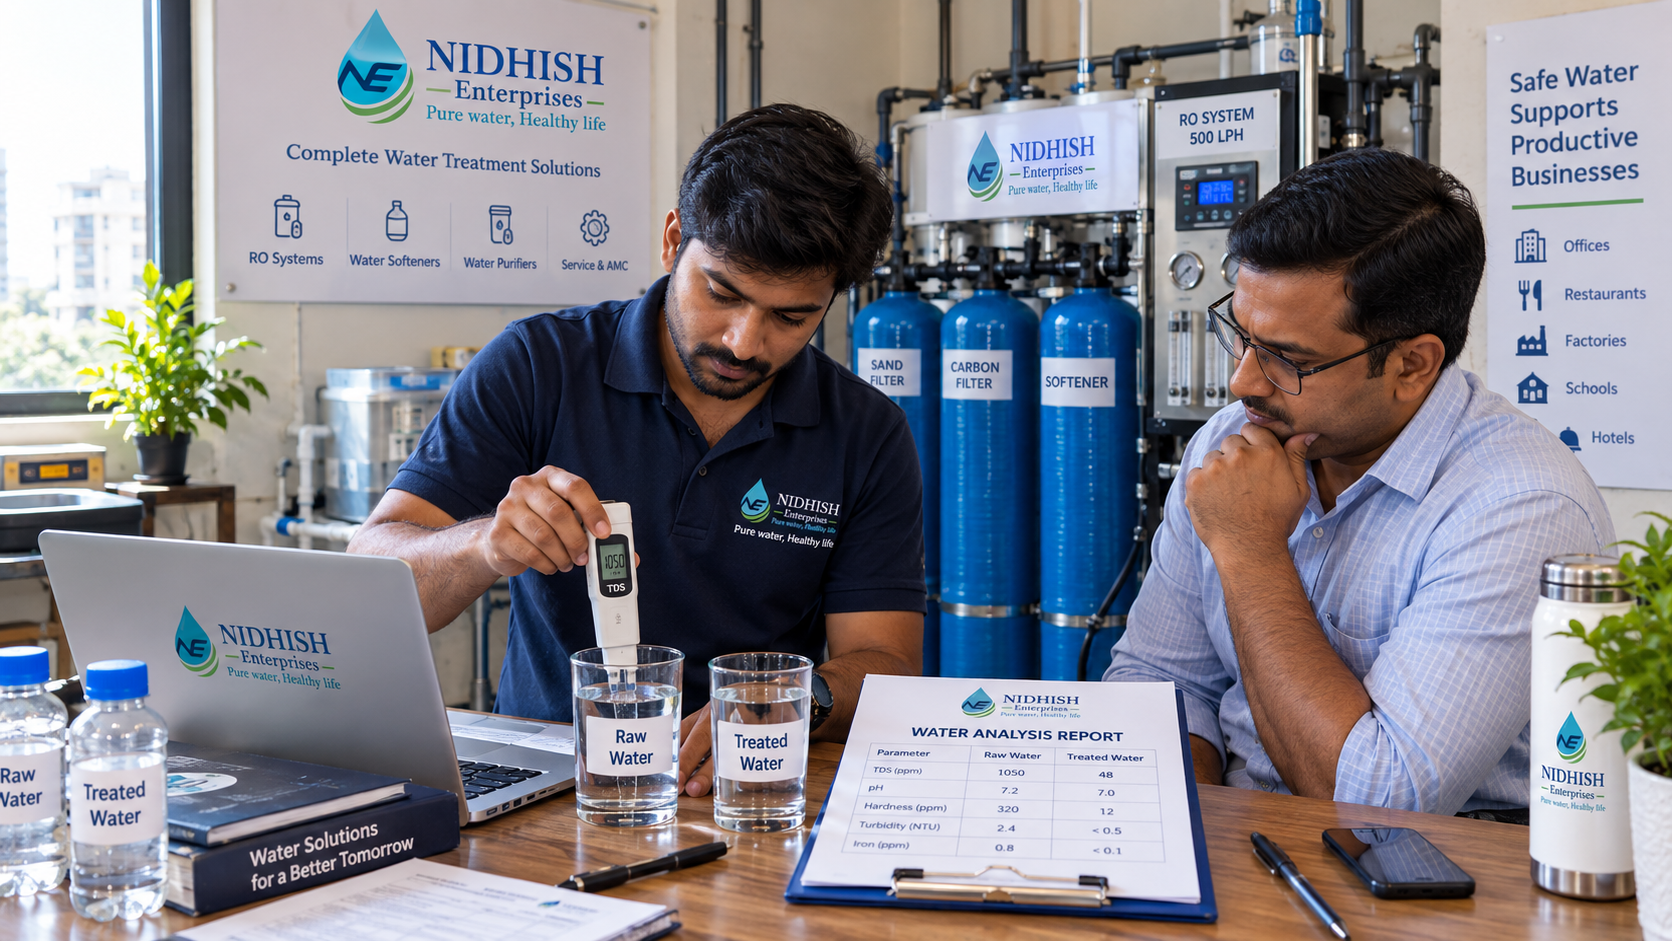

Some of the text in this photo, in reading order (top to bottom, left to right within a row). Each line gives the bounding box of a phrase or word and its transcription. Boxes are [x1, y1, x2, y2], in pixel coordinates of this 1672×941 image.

[425, 39, 605, 85] NIDHISH
[1510, 65, 1639, 93] Safe Water
[454, 80, 583, 110] Enterprises
[427, 105, 607, 133] Pure water, Healthy life
[1179, 107, 1254, 127] RO SYSTEM
[1511, 97, 1619, 128] Supports
[1190, 128, 1244, 145] 500 LPH
[1511, 127, 1638, 156] Productive
[1010, 135, 1095, 163] NIDHISH
[286, 144, 601, 178] Complete Water Treatment Solutions
[1023, 164, 1083, 180] Enterprises
[1512, 163, 1640, 187] Businesses
[1009, 179, 1098, 196] Pure water, Healthy life
[1564, 239, 1610, 253] Offices
[249, 251, 324, 268] RO Systems
[350, 254, 441, 269] Water Softeners
[464, 256, 537, 271] Water Purifiers
[561, 259, 629, 271] Service & AMC
[1564, 287, 1647, 301] Restaurants
[1565, 334, 1627, 347] Factories
[871, 359, 904, 372] SAND
[950, 361, 1000, 374] CARBON
[870, 375, 905, 387] FILTER
[956, 377, 993, 390] FILTER
[1045, 375, 1109, 389] SOFTENER
[1566, 381, 1618, 395] Schools
[1592, 431, 1635, 445] Hotels
[777, 493, 840, 516] NIDHISH
[734, 525, 834, 549] Pure water, Healthy life
[607, 583, 626, 593] TDS
[218, 624, 332, 655] NIDHISH
[240, 650, 320, 671] Enterprises
[227, 666, 341, 690] Pure water, Healthy life
[1003, 695, 1080, 705] NIDHISH
[616, 729, 647, 744] Raw
[734, 733, 788, 749] Treated
[912, 727, 1123, 743] WATER ANALYSIS REPORT
[610, 751, 654, 766] Water
[877, 749, 930, 759] Parameter
[984, 751, 1041, 761] Raw Water
[1067, 753, 1144, 763] Treated Water
[740, 756, 784, 771] Water
[1, 768, 36, 784] Raw
[873, 766, 922, 777] TDS (ppm)
[998, 769, 1025, 777] 1050
[1099, 771, 1114, 780] 48
[1541, 765, 1605, 788] NIDHISH
[84, 781, 146, 801] Treated
[868, 784, 884, 794] pH
[1001, 787, 1019, 796] 7.2
[1098, 789, 1115, 798] 7.0
[1550, 785, 1595, 800] Enterprises
[864, 803, 947, 814] Hardness (ppm)
[998, 805, 1019, 814] 320
[1100, 807, 1114, 816] 12
[90, 810, 141, 827] Water
[859, 821, 941, 832] Turbidity (NTU)
[997, 824, 1016, 833] 2.4
[1103, 827, 1122, 836] 0.5
[250, 822, 379, 867] Water Solutions
[853, 840, 910, 851] Iron (ppm)
[995, 844, 1015, 853] 0.8
[1103, 847, 1122, 856] 0.1
[251, 836, 414, 892] for a Better Tomorrow
